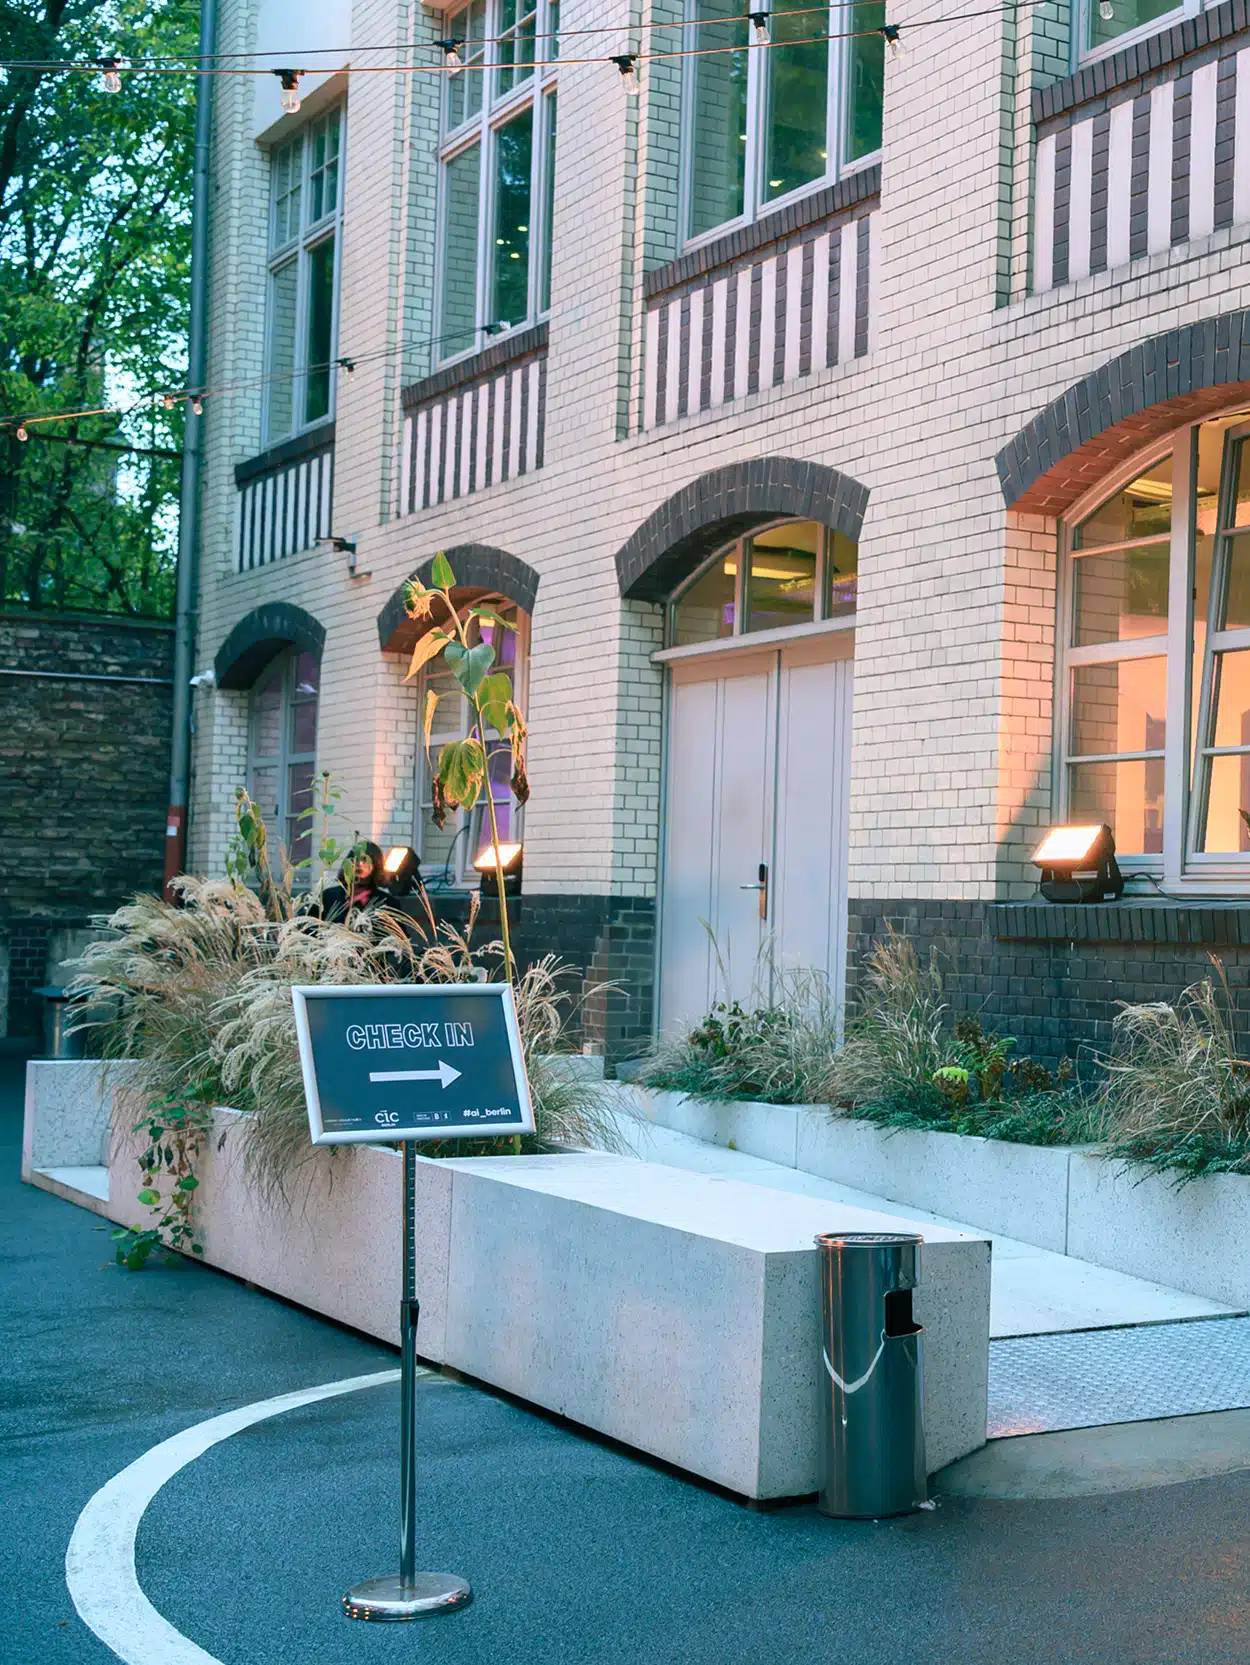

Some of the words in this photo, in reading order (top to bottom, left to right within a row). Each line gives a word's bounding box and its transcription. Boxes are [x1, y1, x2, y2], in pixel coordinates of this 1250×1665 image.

[346, 1023, 442, 1050] CHECK
[445, 1022, 474, 1047] IN
[463, 1107, 512, 1118] #ai_berlin
